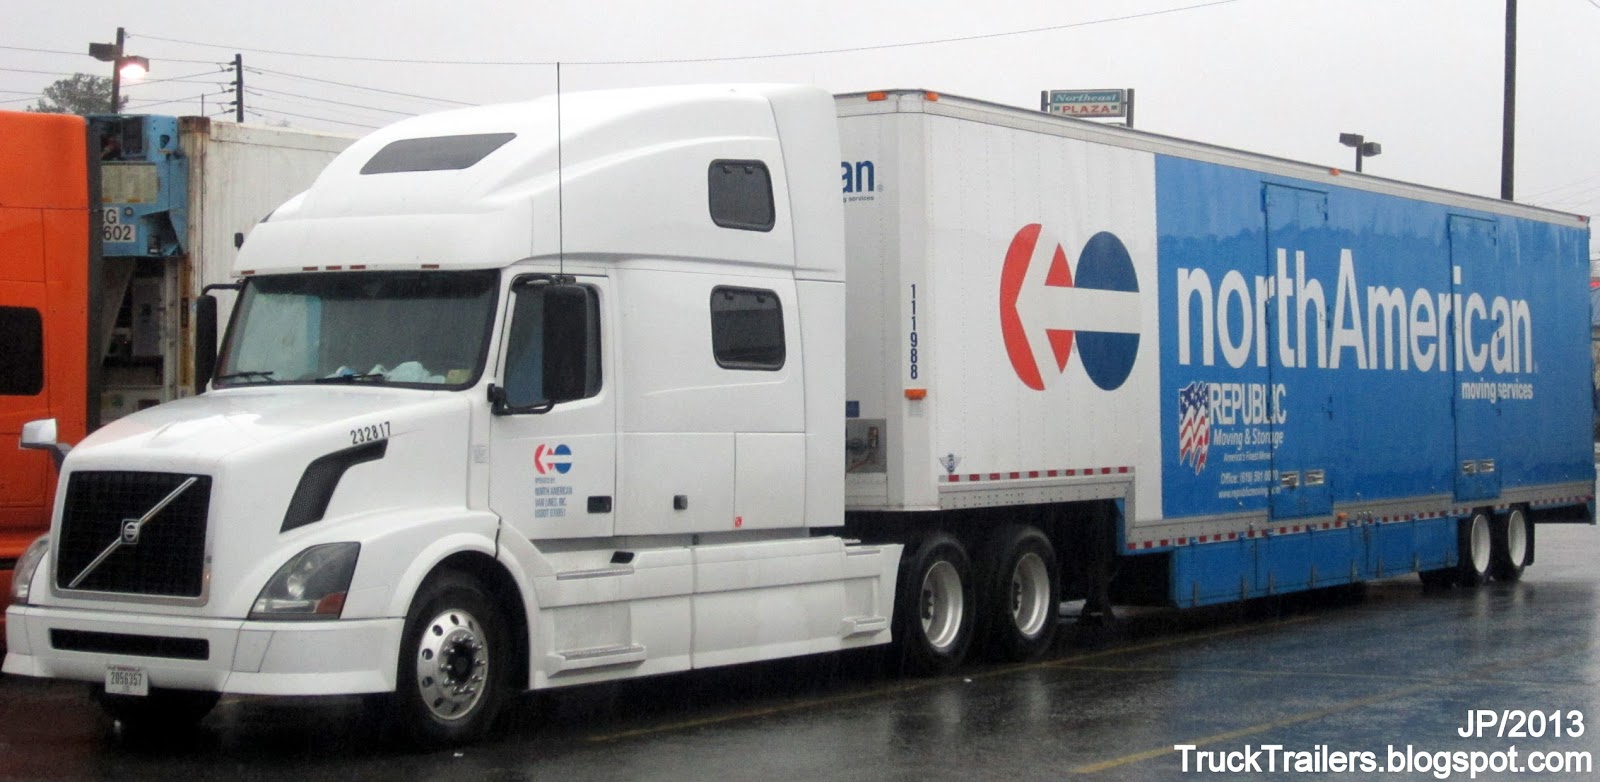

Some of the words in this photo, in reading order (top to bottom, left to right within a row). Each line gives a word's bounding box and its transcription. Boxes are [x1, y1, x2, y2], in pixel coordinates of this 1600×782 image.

[1055, 93, 1117, 103] Northeast
[1062, 105, 1111, 114] PLAZA
[1177, 247, 1533, 374] northAmerican
[910, 283, 918, 380] 111988
[1461, 377, 1496, 404] moving
[1497, 378, 1533, 400] services
[1210, 382, 1287, 425] REPUBLIC
[350, 421, 391, 445] 232817
[1213, 428, 1243, 450] Moving
[1244, 428, 1250, 445] &
[110, 671, 142, 687] 2056357
